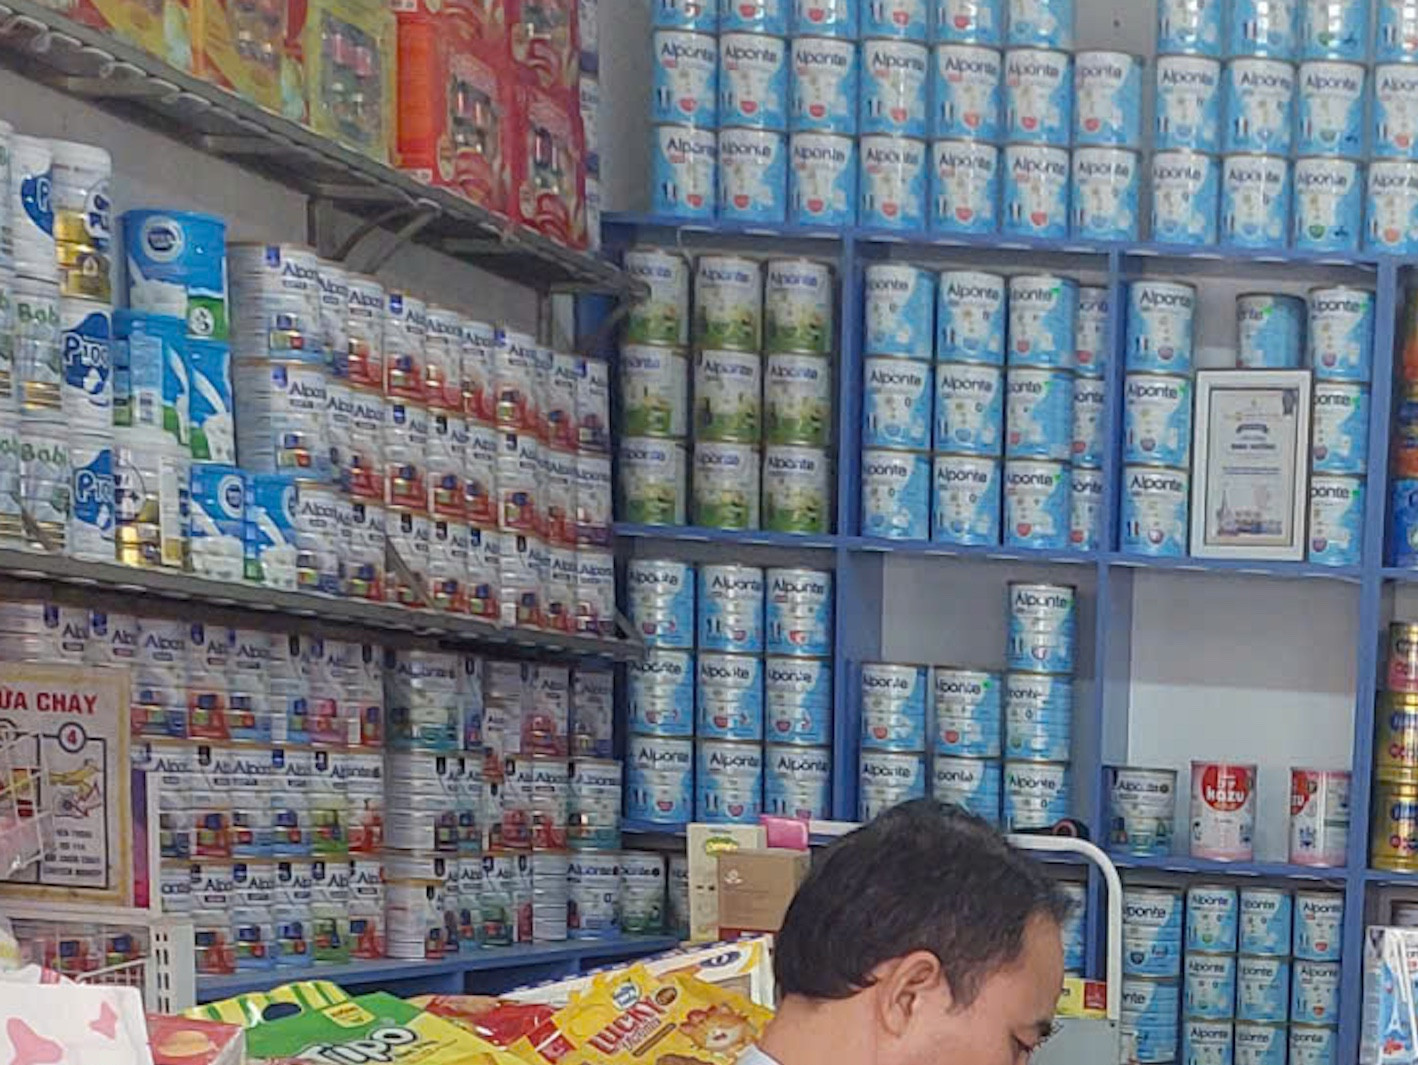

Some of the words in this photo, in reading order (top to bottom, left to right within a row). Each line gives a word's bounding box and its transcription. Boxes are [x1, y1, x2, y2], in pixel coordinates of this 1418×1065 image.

[661, 42, 717, 61] Alponte
[724, 44, 777, 63] Alponte
[873, 52, 925, 72] Alponte
[945, 56, 997, 75] Alponte
[1008, 61, 1059, 80] Alponte
[1160, 68, 1216, 88] Alponte
[1241, 72, 1292, 91] Alponte
[1306, 74, 1359, 93] Alponte
[722, 141, 771, 160] Alponte
[867, 148, 919, 167] Alponte
[940, 152, 992, 172] Alponte
[1013, 158, 1065, 177] Alponte
[1077, 161, 1129, 180] Alponte
[1228, 166, 1280, 186] Alponte
[1299, 170, 1347, 189] Alponte
[947, 283, 999, 302] Alponte
[1140, 289, 1191, 308] Alponte
[870, 370, 922, 389] Alponte
[941, 374, 992, 394] Alponte
[1127, 381, 1177, 399] Alponte
[939, 467, 987, 486] Alponte
[1131, 475, 1183, 492] Alponte
[713, 575, 762, 594] Alponte
[1015, 593, 1067, 609] Alponte
[67, 729, 77, 745] 4
[710, 753, 760, 771] Alponte
[778, 756, 829, 773] Alponte
[1206, 785, 1244, 804] kazu
[1303, 903, 1342, 915] Alponte
